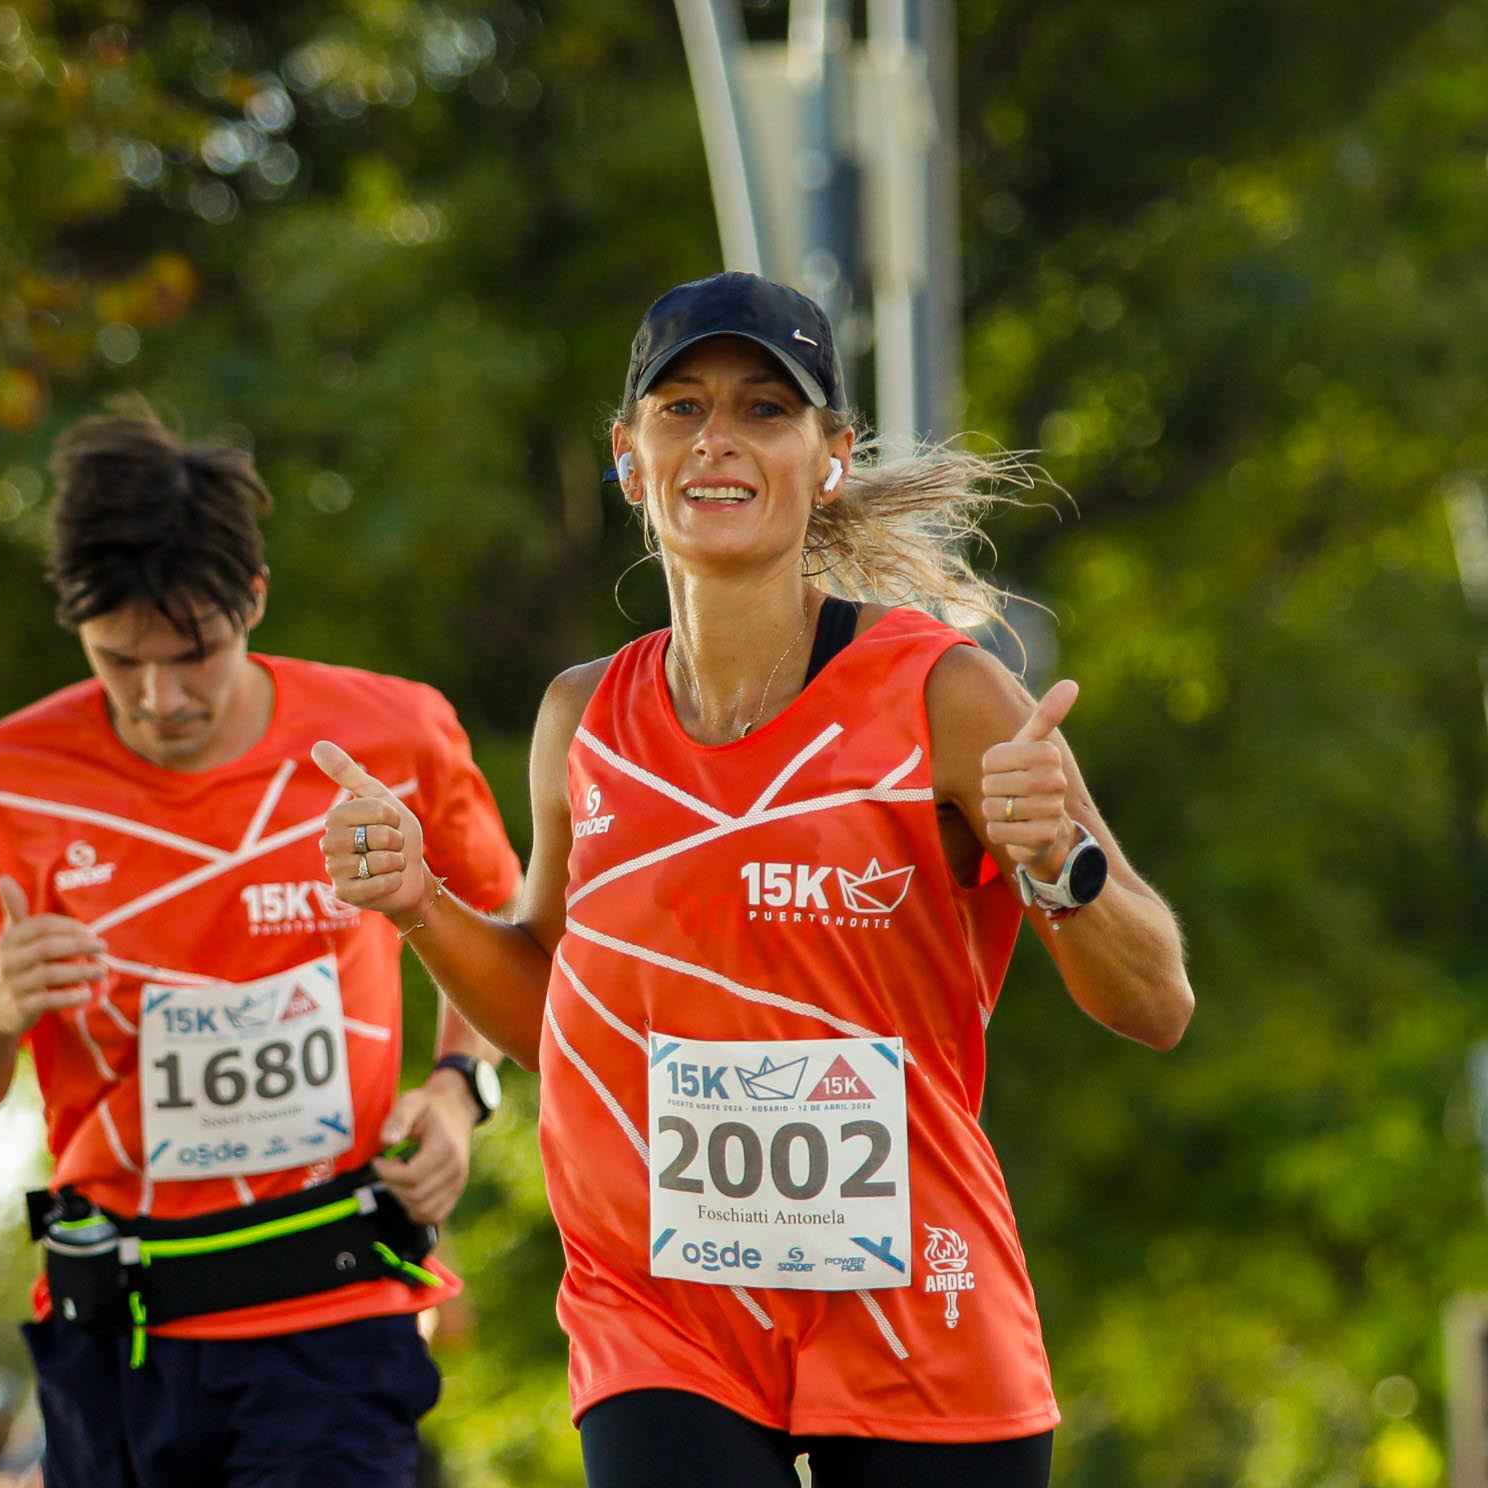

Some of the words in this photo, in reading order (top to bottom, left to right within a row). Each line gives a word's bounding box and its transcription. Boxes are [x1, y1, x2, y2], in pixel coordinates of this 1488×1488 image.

[741, 862, 833, 909] 15K
[240, 881, 315, 922] 15K
[163, 1007, 218, 1033] 15K
[154, 1028, 336, 1108] 1680
[667, 1061, 730, 1100] 15K
[823, 1076, 860, 1095] 15K
[668, 1099, 694, 1109] PUERTO
[696, 1103, 720, 1111] NORTE
[824, 1103, 848, 1111] ABRIL
[179, 1140, 249, 1164] osde
[658, 1115, 896, 1200] 2002
[698, 1205, 768, 1224] Foschiatti
[774, 1209, 845, 1224] Antonela
[682, 1240, 762, 1270] osde
[925, 1272, 975, 1292] ARDEC
